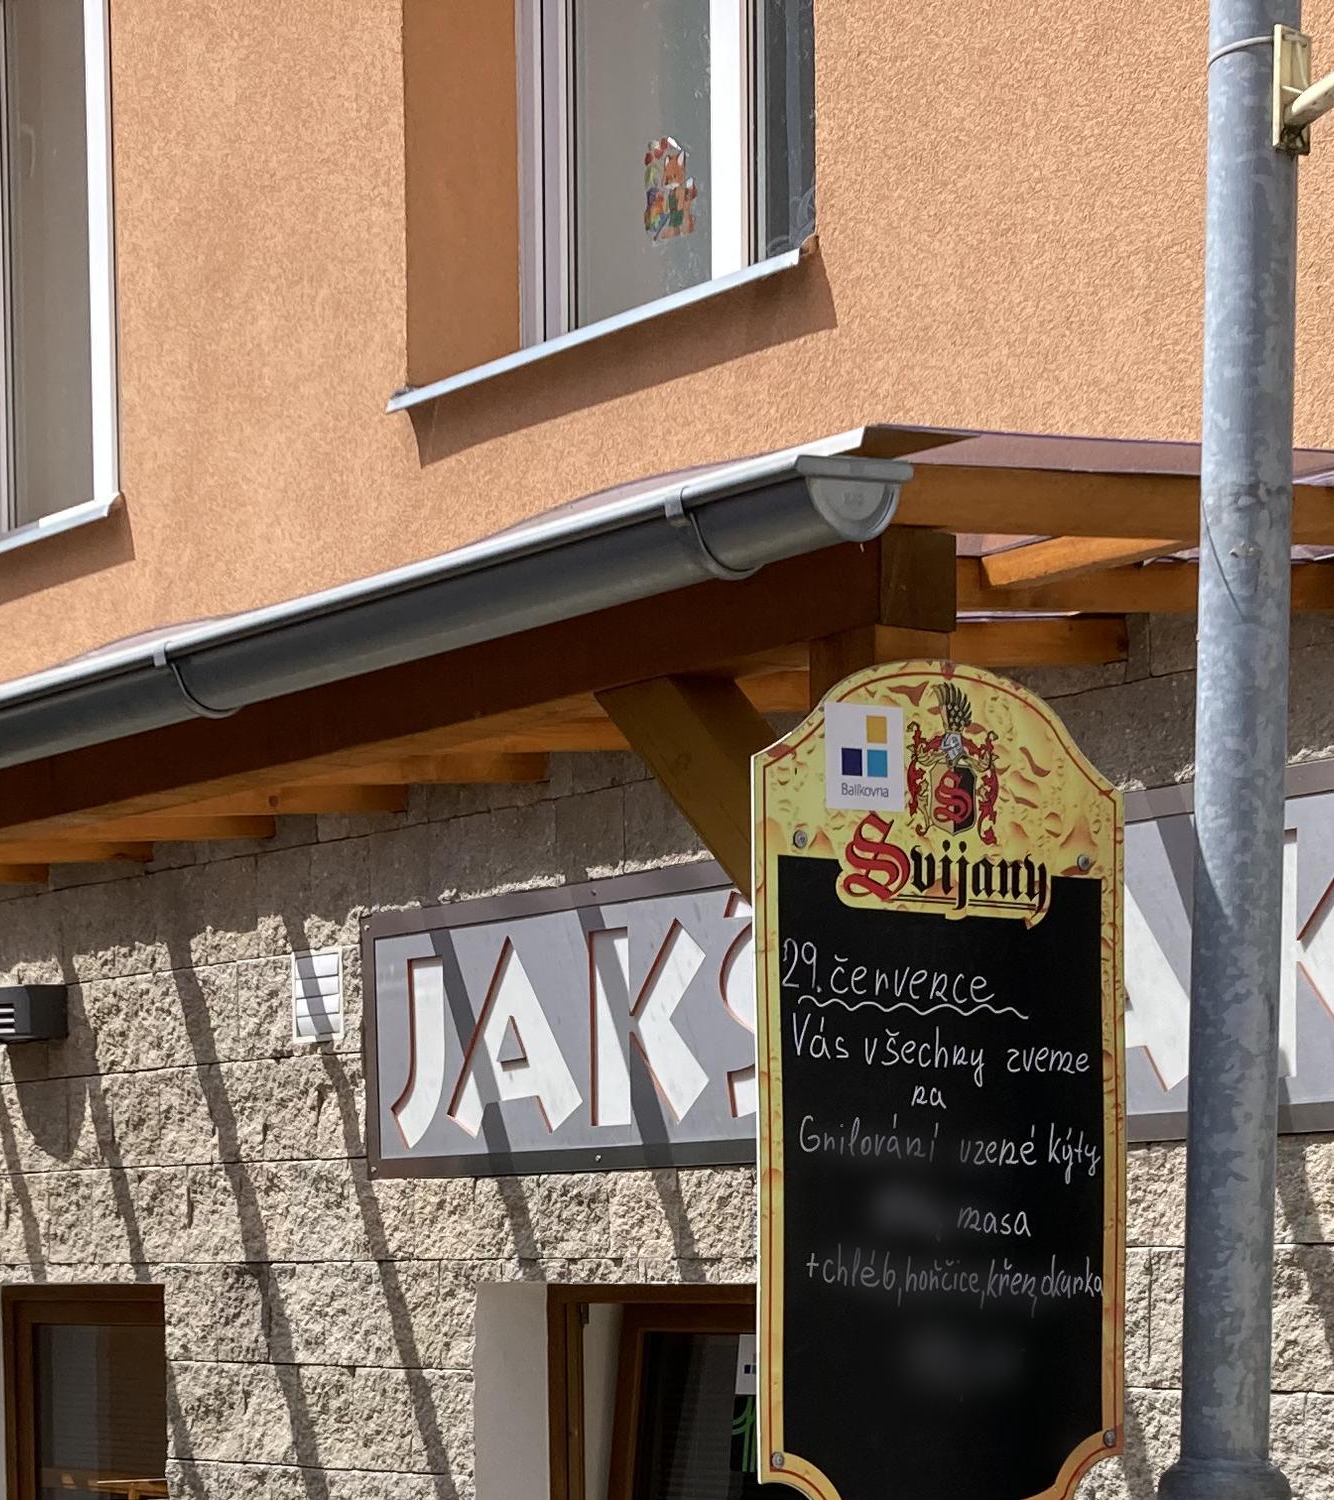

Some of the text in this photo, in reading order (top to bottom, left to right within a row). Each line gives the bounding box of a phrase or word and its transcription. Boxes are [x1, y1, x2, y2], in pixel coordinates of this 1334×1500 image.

[842, 812, 1049, 913] Svijany
[792, 1012, 1090, 1087] Vás všechny zveme
[911, 1084, 947, 1110] na
[960, 1124, 1037, 1166] uzené
[1048, 1122, 1101, 1184] kýty
[956, 1206, 1031, 1237] masa
